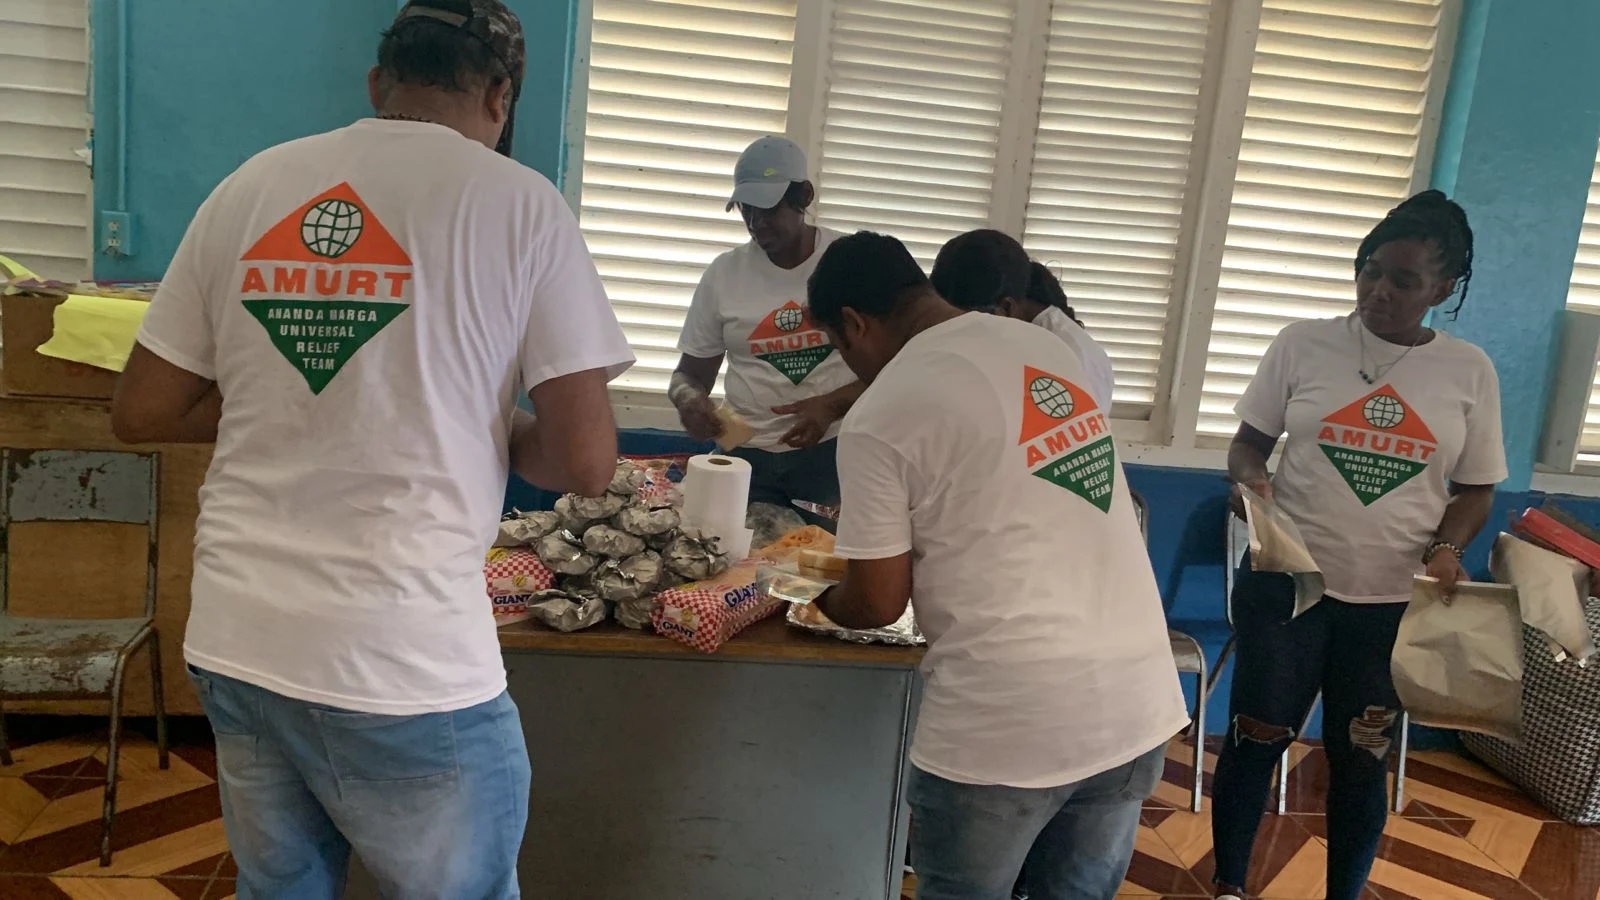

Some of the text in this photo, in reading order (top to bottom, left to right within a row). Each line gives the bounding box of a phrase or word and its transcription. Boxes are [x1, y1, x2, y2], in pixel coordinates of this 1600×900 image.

[241, 267, 412, 298] AMURT
[268, 308, 377, 322] ANANDA MARGA
[280, 325, 355, 337] UNIVERSAL
[296, 342, 340, 353] RELIEF
[750, 332, 823, 354] AMUR
[303, 358, 335, 370] TEAM
[787, 368, 807, 376] TEAM
[1026, 413, 1108, 469] AMURT
[1317, 425, 1437, 461] AMURT
[1053, 452, 1091, 477] ANANDA
[1069, 457, 1111, 483] UNIVERSAL
[1334, 451, 1412, 473] ANANDA MARGA
[1345, 462, 1398, 479] UNIVERSAL
[1083, 471, 1109, 490] RELIEF
[1353, 473, 1387, 485] RELIEF
[1089, 483, 1111, 500] TEAM
[1355, 484, 1381, 494] TEAM
